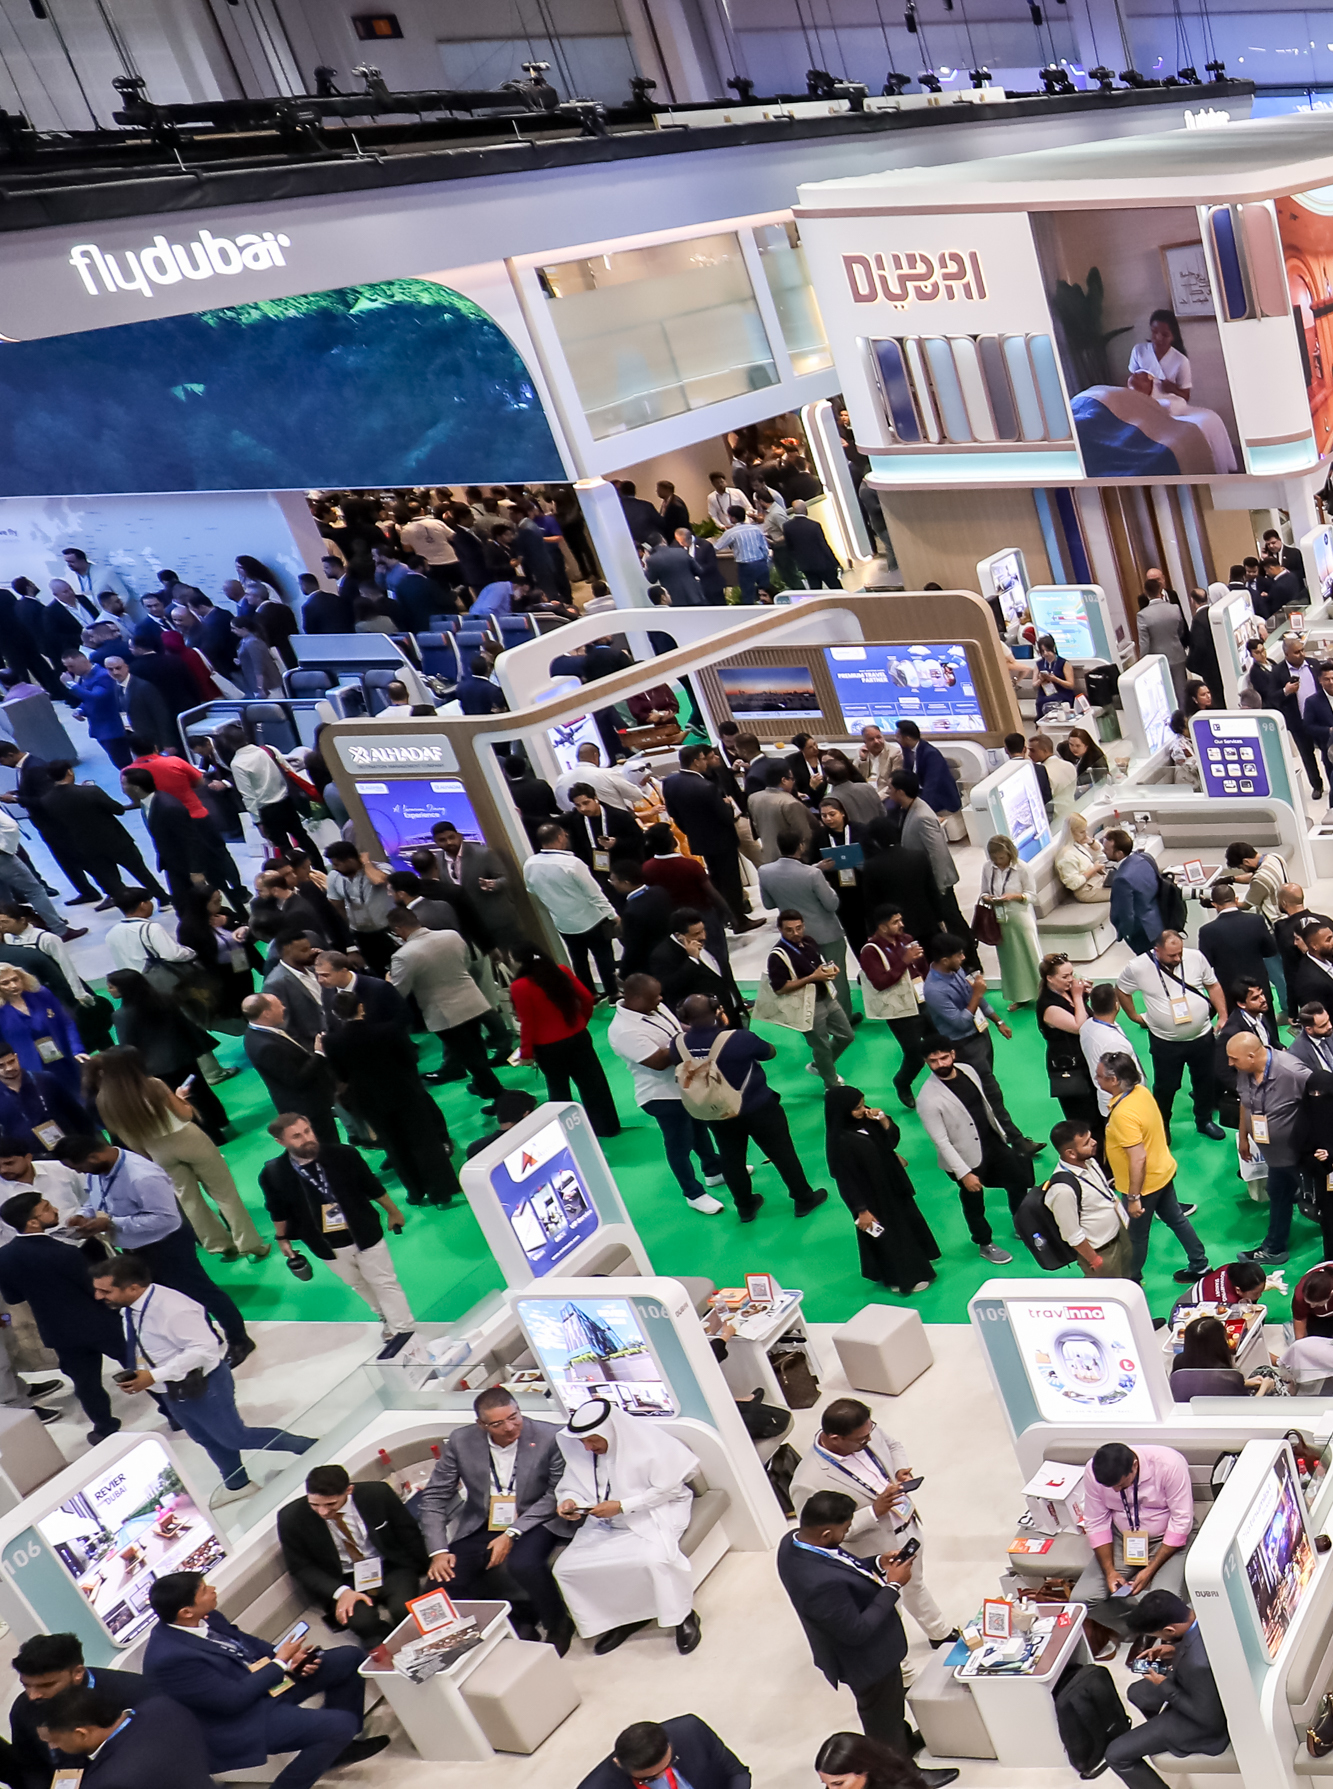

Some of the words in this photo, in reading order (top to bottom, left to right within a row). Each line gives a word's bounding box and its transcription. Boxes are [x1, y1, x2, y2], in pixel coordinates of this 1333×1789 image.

[68, 229, 292, 297] flydubai
[841, 250, 989, 311] DUBAI
[1262, 722, 1275, 731] 98
[370, 746, 444, 763] ALHADAF
[637, 1304, 670, 1320] 106
[976, 1306, 1007, 1322] 109
[1028, 1306, 1104, 1321] travinno
[94, 1473, 127, 1500] REVIER
[106, 1486, 128, 1505] DUBAI
[3, 1540, 42, 1576] 106
[1194, 1590, 1220, 1598] DUBAI
